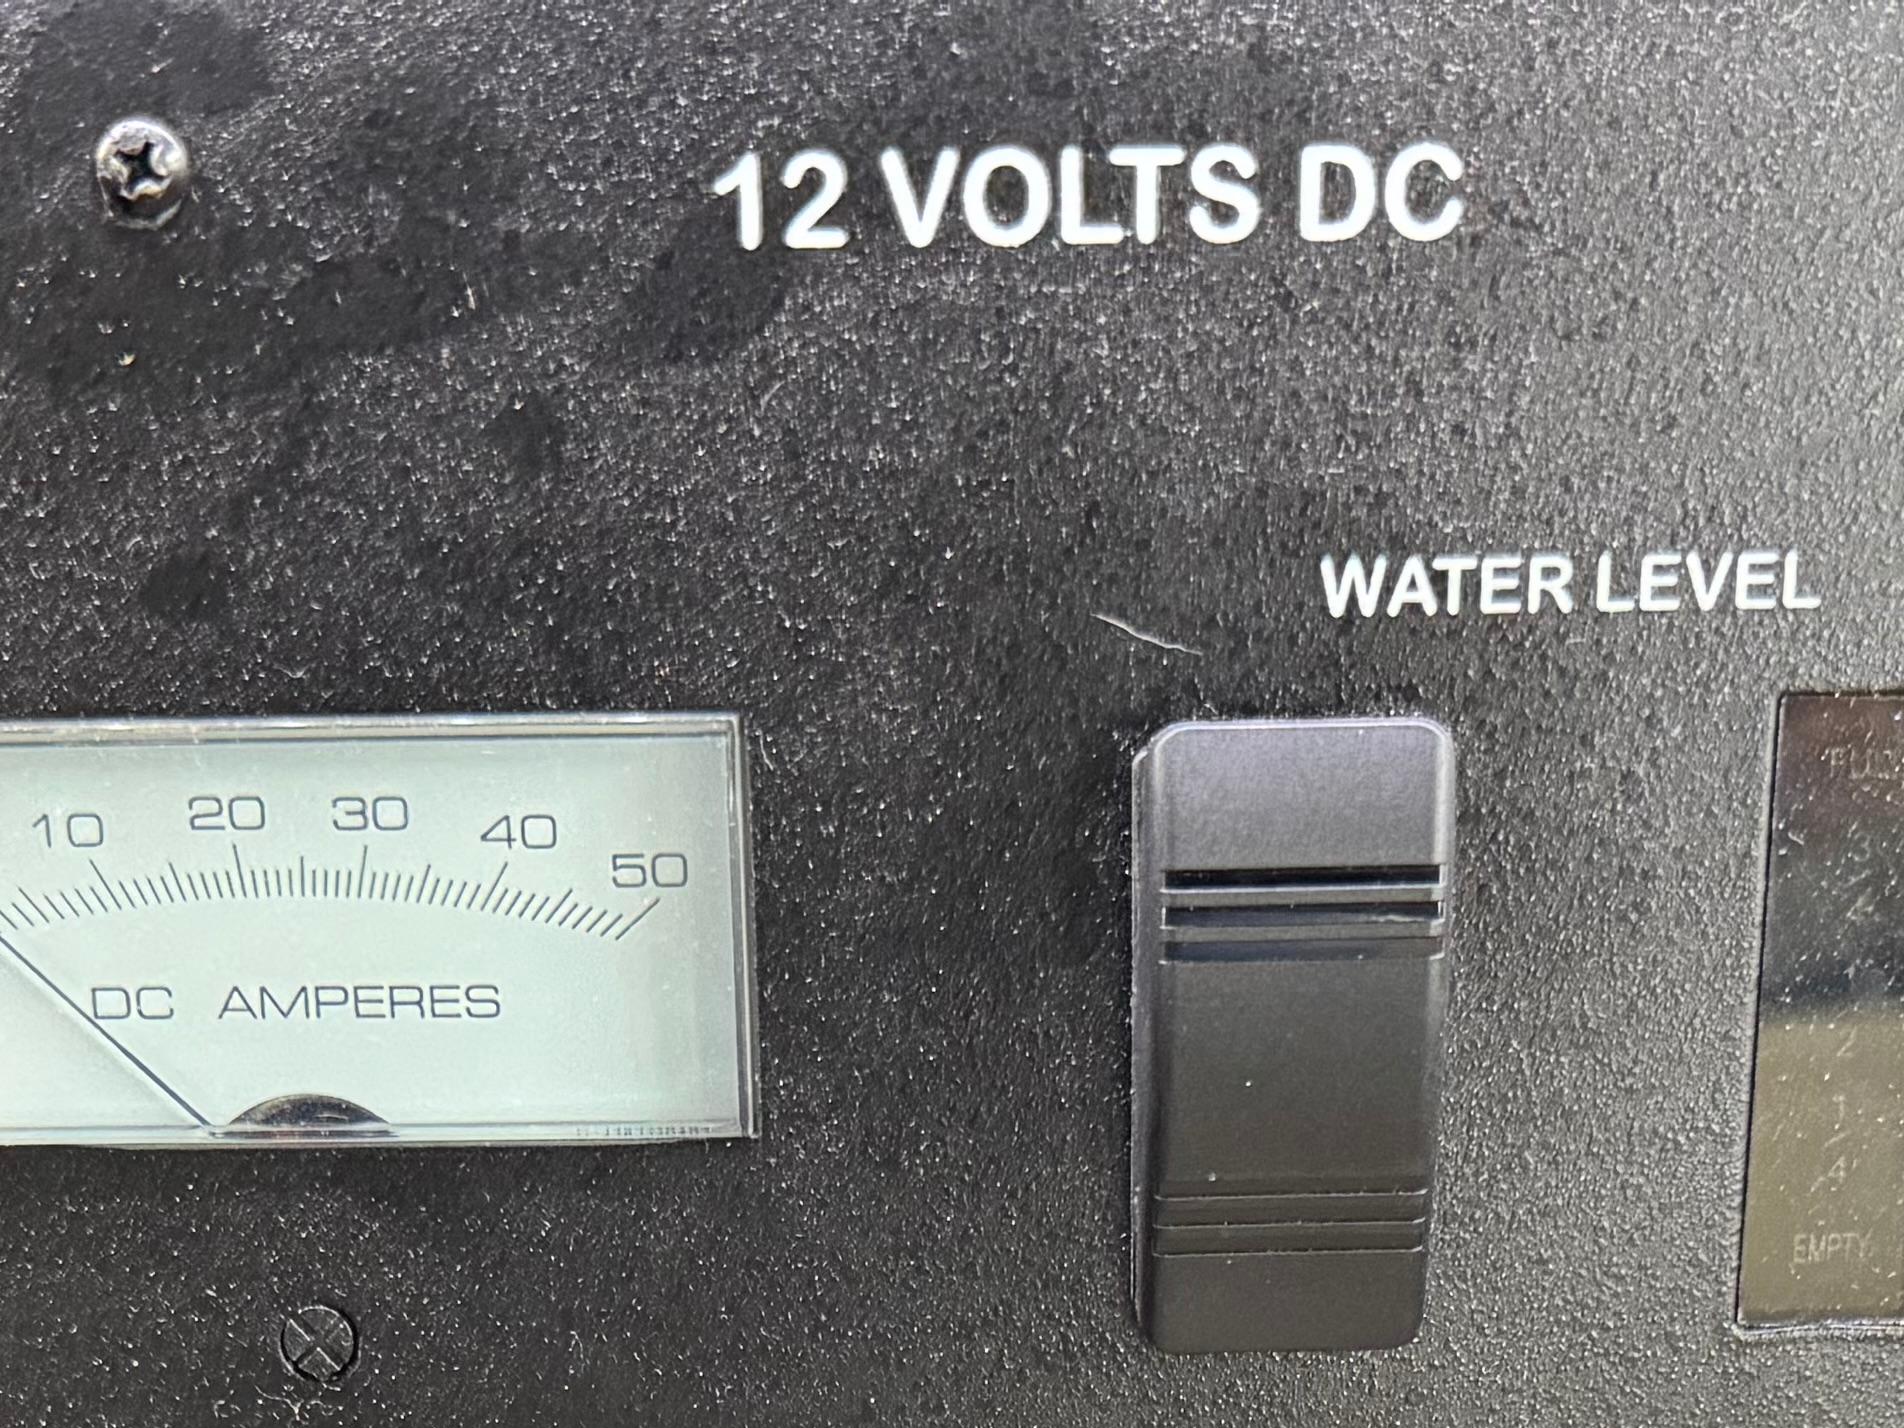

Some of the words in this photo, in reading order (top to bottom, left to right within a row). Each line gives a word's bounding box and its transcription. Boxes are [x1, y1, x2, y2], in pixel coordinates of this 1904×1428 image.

[712, 149, 849, 251] 12
[880, 143, 1263, 250] VOLTS
[1299, 140, 1465, 242] DC
[1320, 551, 1574, 618] WATER
[1596, 547, 1822, 613] LEVEL
[32, 812, 105, 848] 10
[187, 795, 266, 831] 20
[331, 795, 409, 832] 30
[479, 813, 558, 850] 40
[611, 852, 689, 889] 50
[89, 984, 176, 1023] DC
[218, 984, 501, 1020] AMPERES
[1792, 1233, 1874, 1265] EMPTY
